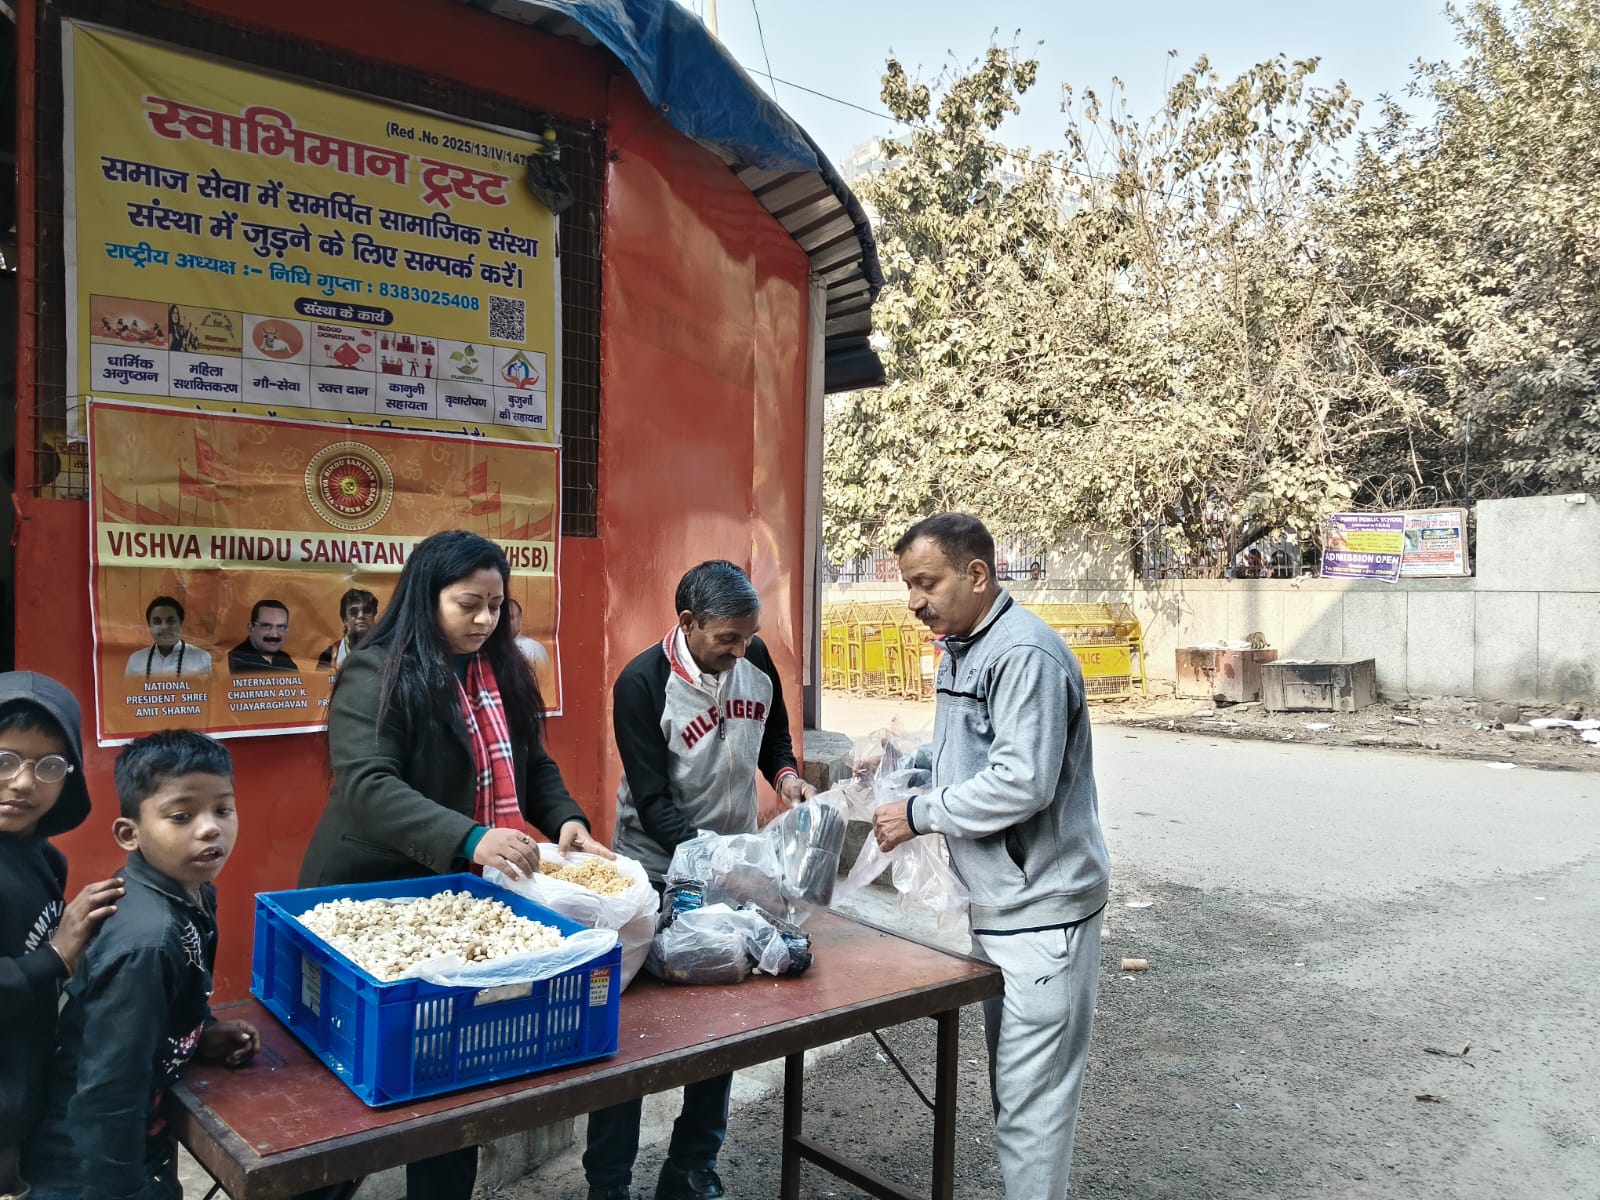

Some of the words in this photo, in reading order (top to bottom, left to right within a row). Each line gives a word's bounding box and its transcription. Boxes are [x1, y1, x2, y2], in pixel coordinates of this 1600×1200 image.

[386, 121, 415, 141] (Red
[147, 96, 410, 185] स्वाभिमान
[421, 158, 510, 208] ट्रस्ट
[101, 155, 190, 193] समाज
[196, 168, 251, 204] सेवा
[256, 179, 284, 208] में
[286, 191, 373, 226] समर्पित
[379, 208, 483, 245] सामाजिक
[487, 227, 539, 258] संस्था
[127, 198, 203, 235] संस्था
[209, 210, 239, 240] में
[241, 222, 312, 258] जुड़ने
[317, 229, 346, 257] के
[351, 233, 399, 268] लिए
[403, 249, 475, 279] सम्पर्क
[104, 242, 170, 268] राष्ट्रीय
[175, 252, 237, 275] अध्यक्ष
[269, 262, 311, 288] निधि
[318, 273, 363, 296] गुप्ता
[379, 283, 480, 311] 8383025408
[303, 302, 337, 317] संस्था
[341, 306, 354, 319] के
[358, 309, 385, 323] कार्य
[107, 353, 154, 370] धार्मिक
[189, 361, 224, 377] महिला
[102, 367, 159, 385] अनुष्ठान
[252, 375, 301, 392] गौ-सेवा
[173, 377, 239, 394] सशक्तिकरण
[318, 382, 343, 395] रक्त
[346, 384, 369, 396] दान
[385, 398, 429, 411] सहायता
[499, 410, 511, 422] की
[512, 411, 543, 424] सहायता
[107, 530, 202, 560] VISHVA
[210, 535, 291, 562] HINDU
[300, 538, 404, 565] SANATAN
[1325, 552, 1374, 563] ADMISSION
[1375, 555, 1400, 565] OPEN
[144, 681, 191, 692] NATIONAL
[232, 677, 303, 688] INTERNATIONAL
[126, 694, 176, 705] PRESIDENT
[180, 692, 209, 702] SHREE
[227, 689, 276, 700] CHAIRMAN
[135, 707, 159, 717] AMIT
[161, 706, 201, 716] SHARMA
[229, 700, 308, 712] VIJAYARAGHAVAN
